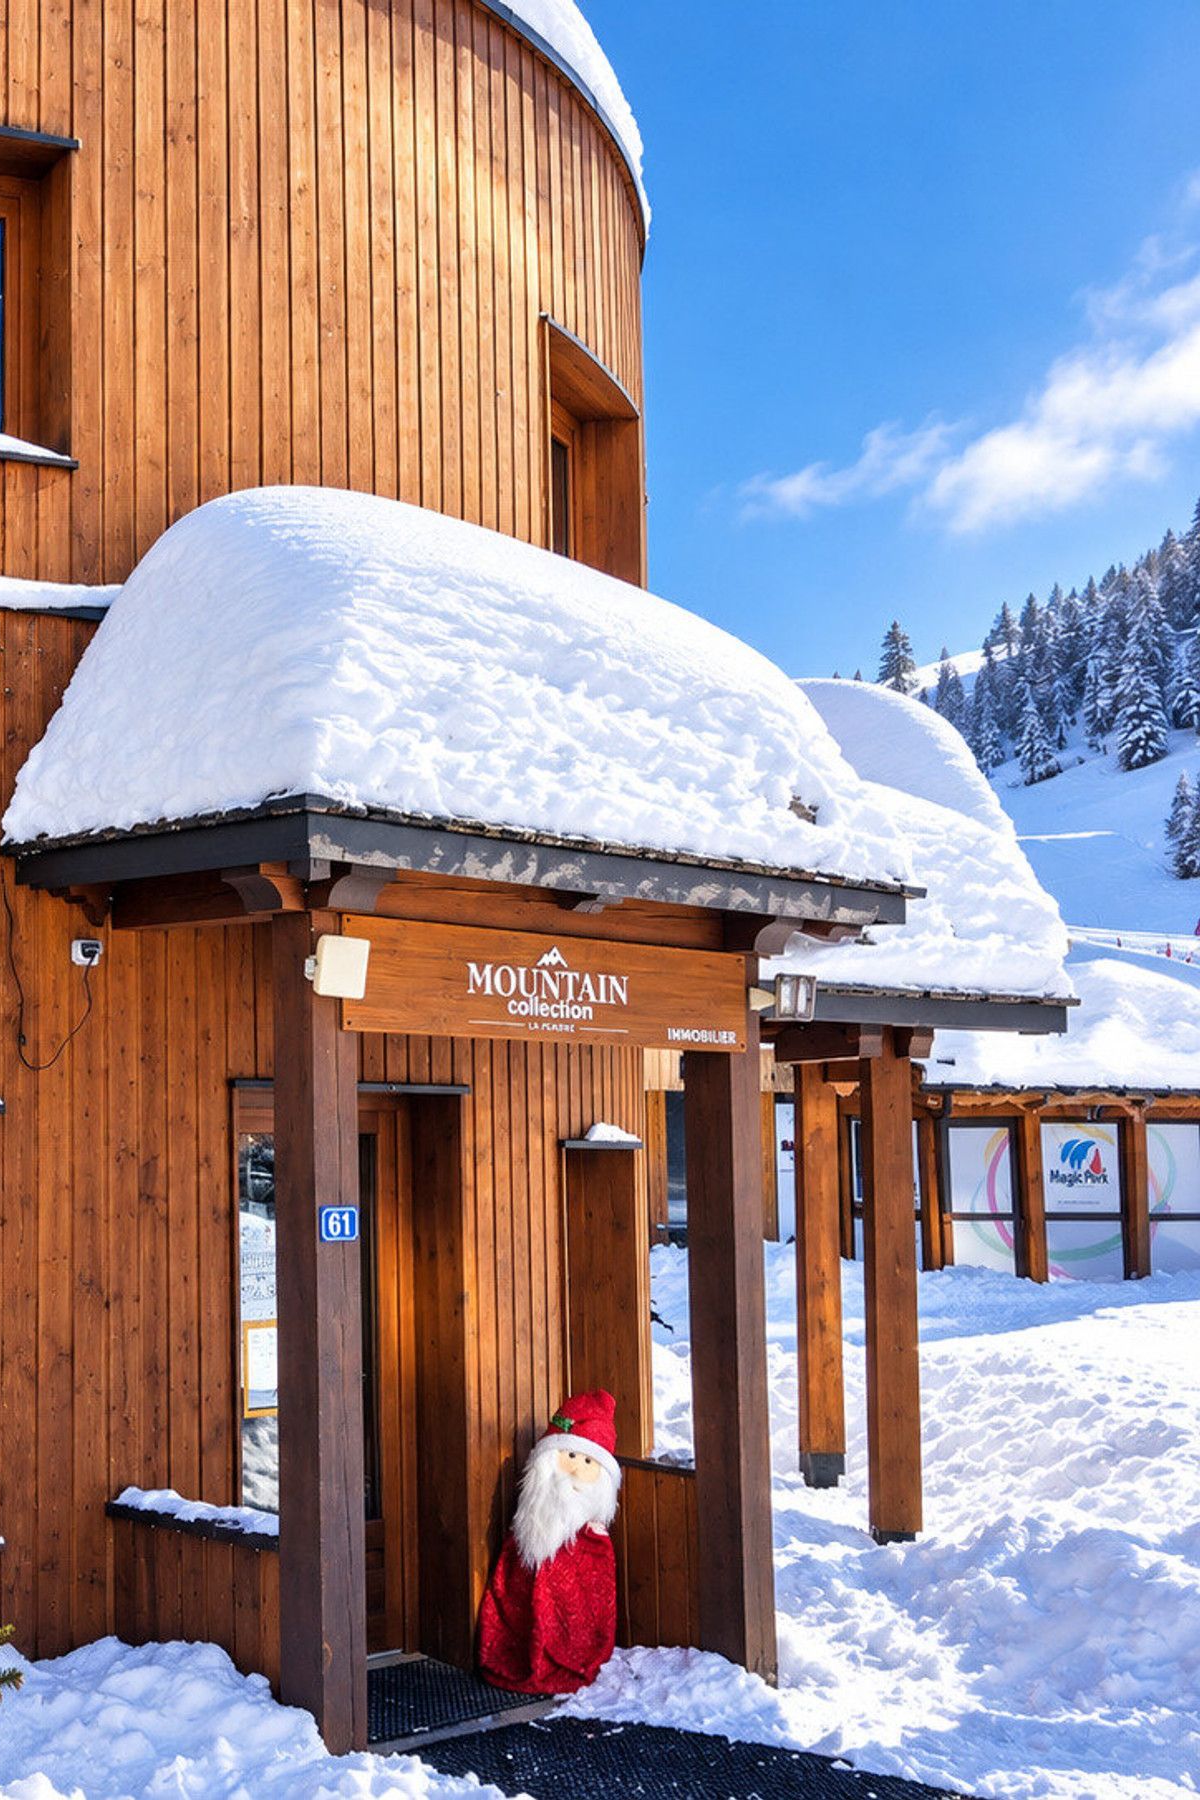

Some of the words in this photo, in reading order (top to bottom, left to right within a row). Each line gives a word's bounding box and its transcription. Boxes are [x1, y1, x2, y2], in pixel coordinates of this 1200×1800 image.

[466, 962, 629, 1005] MOUNTAIN
[508, 995, 593, 1020] collection
[667, 1027, 737, 1044] IMMOBILIER
[328, 1211, 350, 1236] 61
